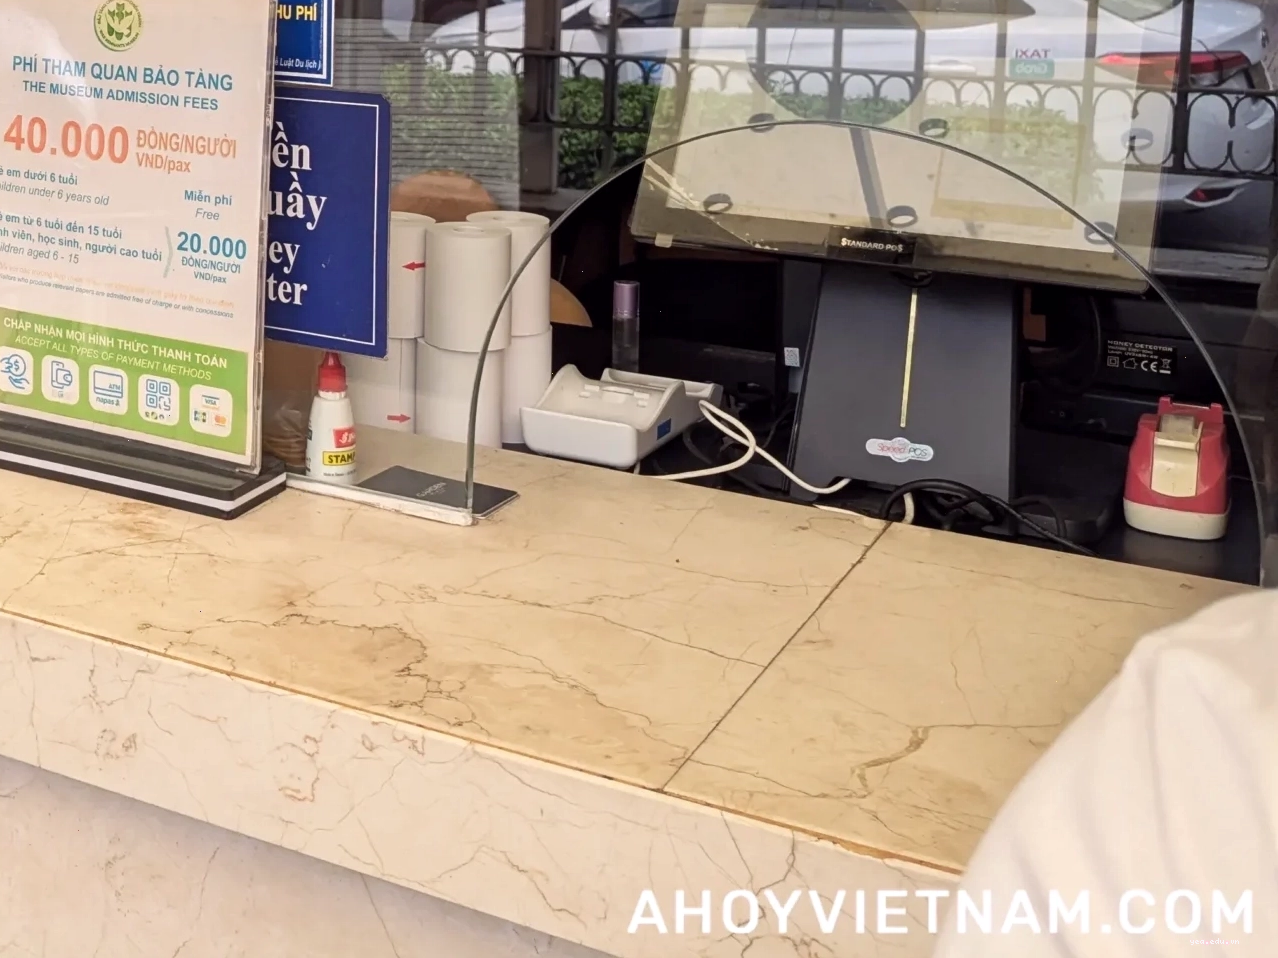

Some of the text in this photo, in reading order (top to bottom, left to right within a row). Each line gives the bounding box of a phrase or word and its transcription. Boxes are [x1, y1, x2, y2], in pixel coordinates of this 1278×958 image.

[277, 3, 317, 21] HU PHÍ
[13, 54, 233, 91] PHÍ THAM QUAN BẢO TÀNG
[295, 59, 304, 67] Du
[22, 81, 218, 110] THE MUSEUM ADMISSION FEES
[4, 115, 129, 163] 40.000
[272, 122, 312, 171] ền
[136, 152, 190, 174] VND/pax
[7, 169, 20, 177] em
[24, 170, 47, 181] dưới
[50, 173, 55, 182] 6
[59, 173, 77, 185] tuổi
[29, 187, 55, 198] under
[57, 190, 63, 199] 6
[65, 193, 91, 203] years
[95, 196, 109, 205] old
[185, 190, 232, 206] Miễn phí
[268, 172, 327, 230] uầy
[6, 214, 19, 223] em
[23, 214, 34, 225] từ
[37, 217, 42, 226] 6
[45, 217, 63, 230] tuổi
[66, 222, 84, 234] đến
[88, 225, 99, 236] 15
[102, 226, 122, 239] tuổi
[195, 208, 219, 220] Free
[12, 231, 34, 242] viên,
[38, 234, 55, 247] học
[59, 237, 81, 250] sinh,
[85, 243, 116, 255] người
[120, 247, 138, 257] cao
[142, 248, 162, 261] tuổi
[27, 247, 50, 260] aged
[53, 251, 58, 260] 6
[69, 253, 79, 264] 15
[177, 231, 246, 259] 20.000
[194, 271, 226, 284] VND/pax
[29, 279, 51, 287] produce
[53, 283, 74, 291] relevant
[76, 287, 94, 295] papers
[107, 292, 131, 301] admitted
[152, 299, 172, 308] charge
[195, 307, 233, 318] concessions
[15, 335, 212, 380] ACCEPT ALL TYPES OF PAYMENT METHODS
[66, 330, 85, 343] MỌI
[117, 339, 148, 354] THỨC
[152, 345, 191, 362] THANH
[195, 353, 227, 368] TOÁN
